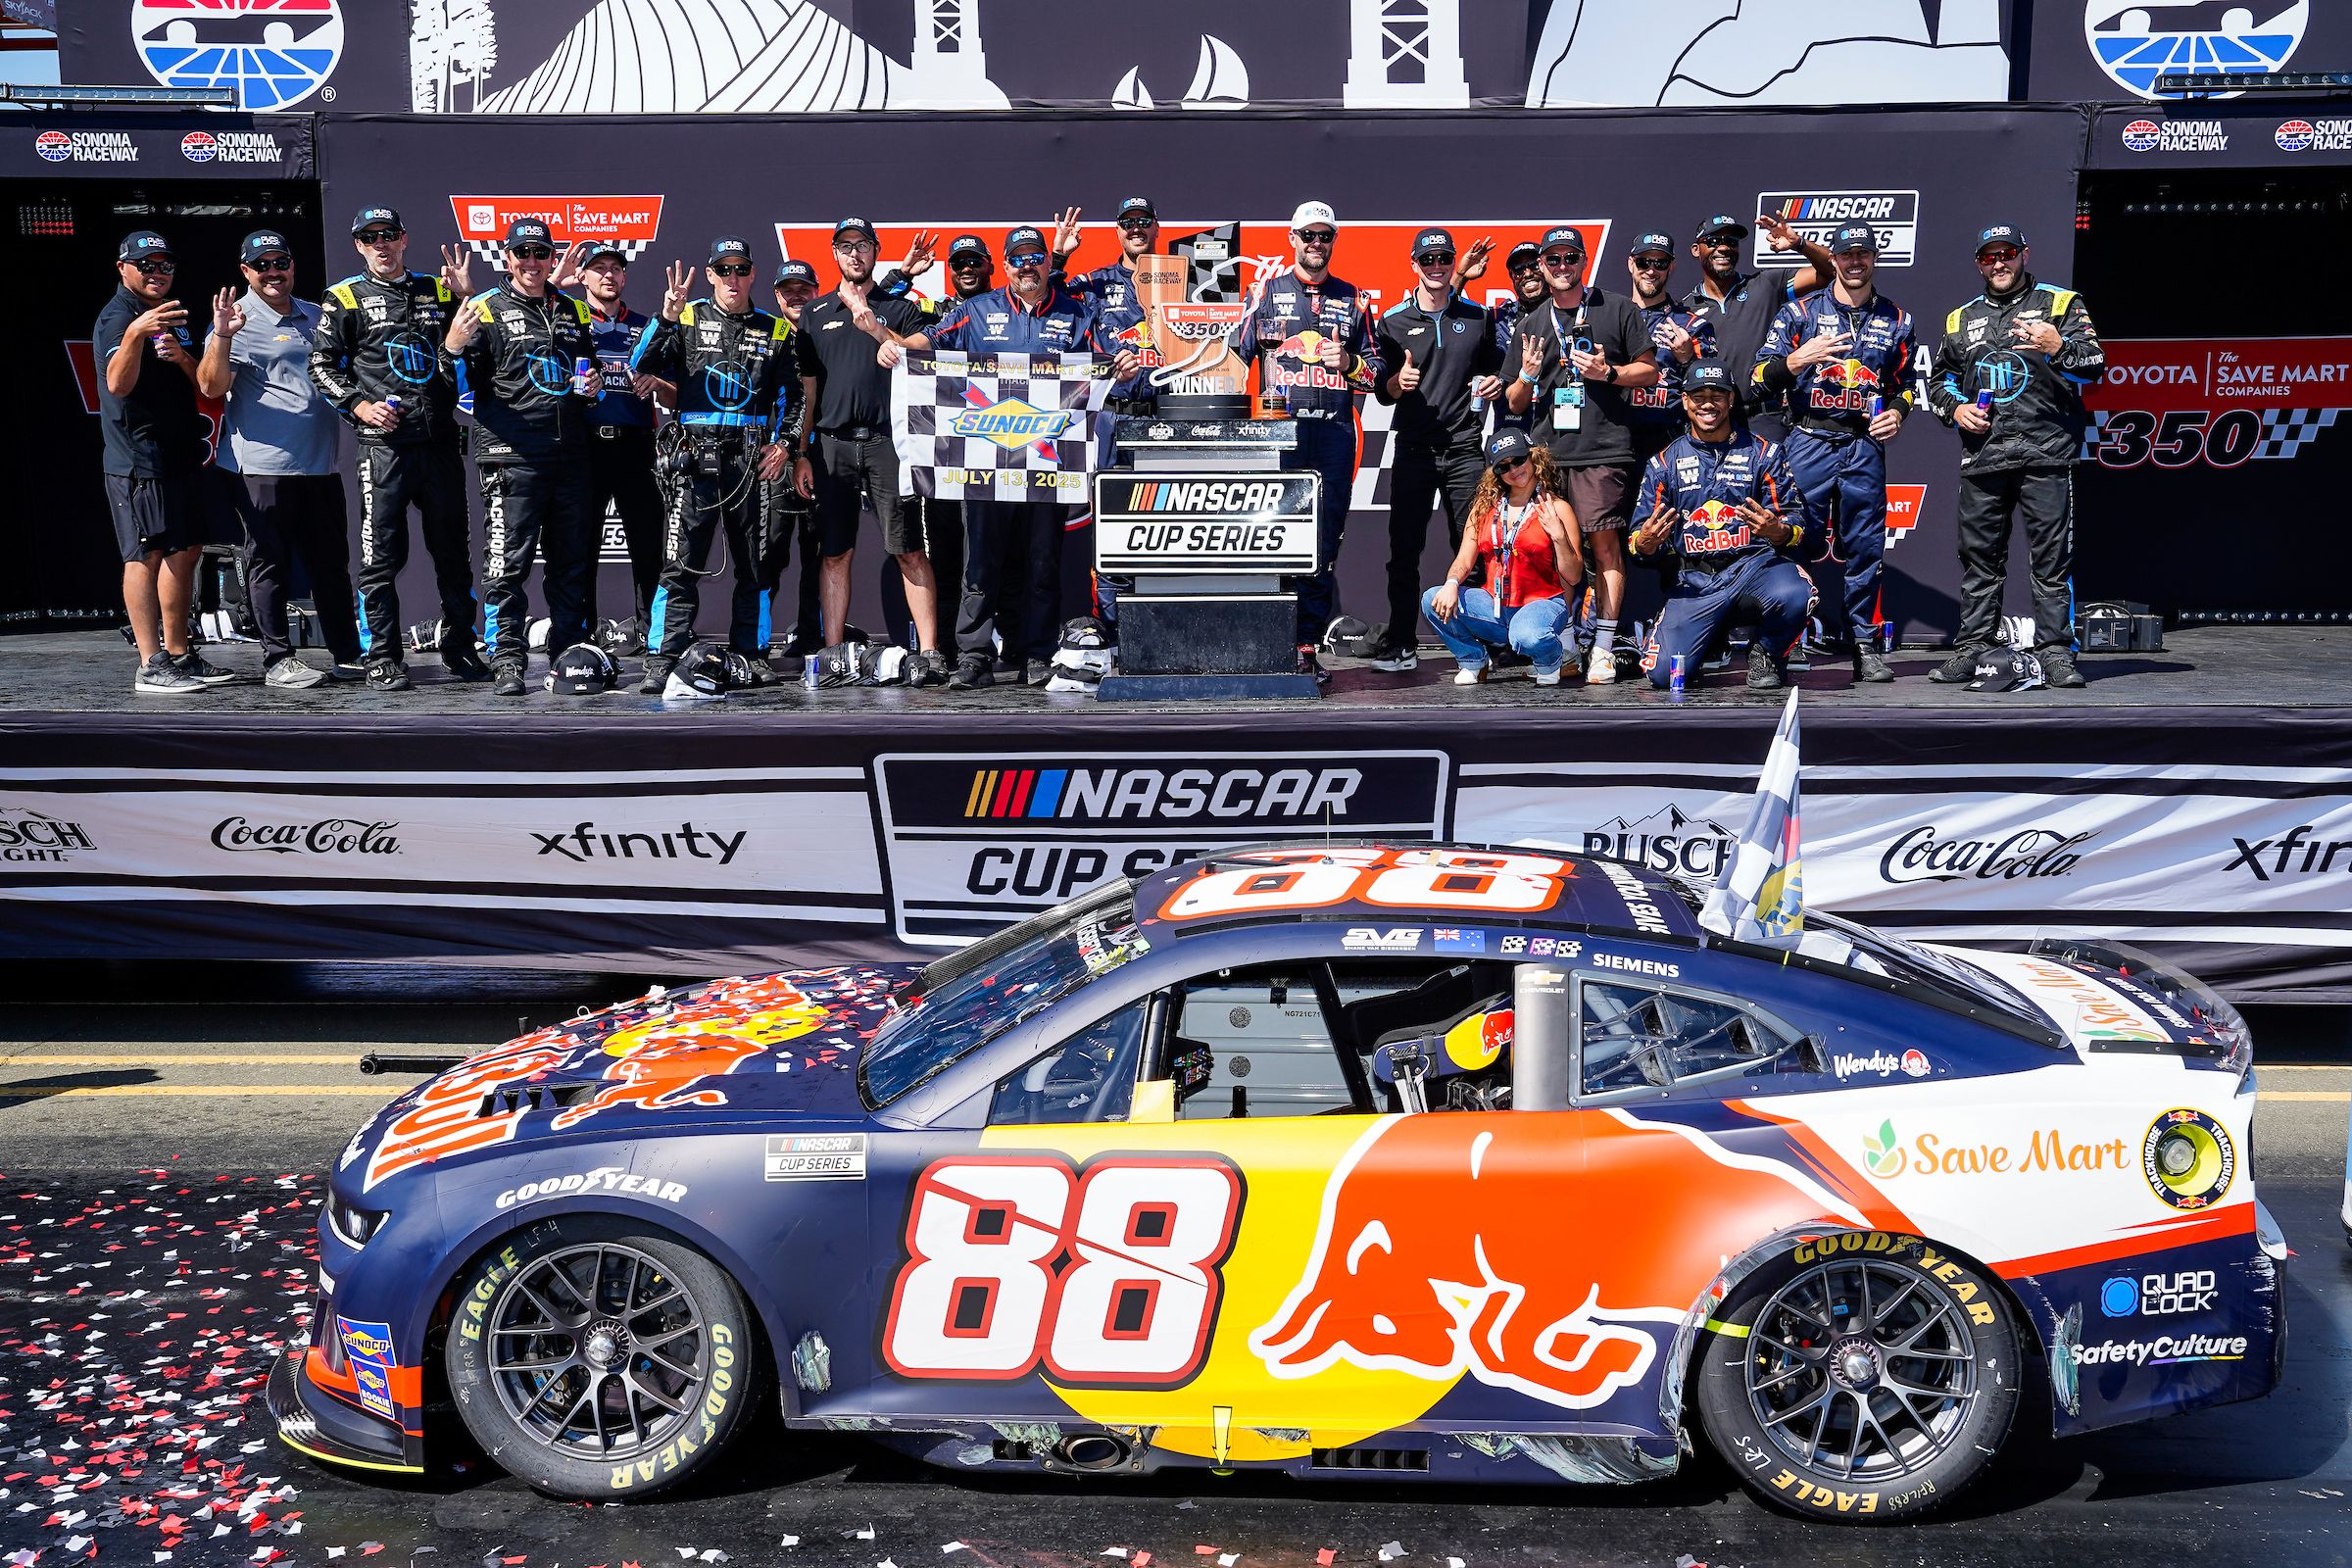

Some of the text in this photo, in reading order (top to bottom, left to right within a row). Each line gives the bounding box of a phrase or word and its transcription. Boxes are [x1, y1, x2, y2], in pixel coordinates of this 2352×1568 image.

[4, 0, 42, 20] SKYJACK
[2161, 122, 2223, 135] SONOMA
[73, 132, 131, 147] SONOMA
[218, 133, 275, 148] SONOMA
[2160, 135, 2229, 151] RACEWAY
[74, 146, 139, 162] RACEWAY
[218, 147, 282, 162] RACEWAY
[573, 204, 586, 213] The
[573, 213, 607, 224] SAVE
[612, 213, 650, 223] MART
[1808, 198, 1895, 219] NASCAR
[1795, 230, 1820, 246] UP
[1184, 322, 1220, 336] 350
[2219, 352, 2239, 364] The
[1032, 364, 1076, 375] MART
[1081, 365, 1109, 376] 350
[2217, 365, 2275, 383] SAVE
[2281, 364, 2349, 383] MART
[1171, 375, 1235, 394] WINNER
[2216, 386, 2291, 397] COMPANIES
[1632, 387, 1668, 409] Bull
[1810, 388, 1849, 410] Red
[959, 415, 1064, 434] SUNOCO
[1148, 424, 1271, 437] BUSCH Coca-Cola xfinity
[2097, 410, 2263, 468] 350
[943, 469, 1081, 489] JULY 13, 2025
[1165, 482, 1286, 512] NASCAR
[1886, 501, 1911, 514] ART
[1127, 525, 1287, 551] CUP SERIES
[1684, 525, 1751, 554] Red Bull
[1059, 768, 1363, 818] NASCAR
[211, 815, 403, 856] Coca-Cola
[529, 821, 748, 864] xfinity
[1880, 826, 2102, 883] Coca-Cola
[965, 848, 1108, 898] CUP
[1157, 848, 1576, 921] 88
[1341, 928, 1424, 948] SVG
[1592, 952, 1680, 979] SIEMENS
[1834, 1050, 1899, 1078] Wendy's
[798, 1137, 852, 1152] NASCAR
[1914, 1130, 2131, 1175] Save Mart
[779, 1157, 852, 1170] CUP SERIES
[2143, 1125, 2168, 1198] TRACKHOUSE
[2210, 1122, 2235, 1194] TRACKHOUSE
[495, 1166, 688, 1209] GOODYEAR
[879, 1152, 1244, 1388] 88
[1792, 1231, 1997, 1328] GOODYEAR
[2142, 1271, 2216, 1296] QUAD
[460, 1246, 520, 1342] EAGLE
[2141, 1293, 2213, 1316] LOCK
[345, 1335, 388, 1352] SUNOCO
[2070, 1334, 2248, 1366] SafetyCulture
[358, 1372, 385, 1388] SUNOCO
[361, 1389, 391, 1408] ROOKIE
[611, 1323, 735, 1490] GOODYEAR
[1769, 1468, 1880, 1513] EAGLE
